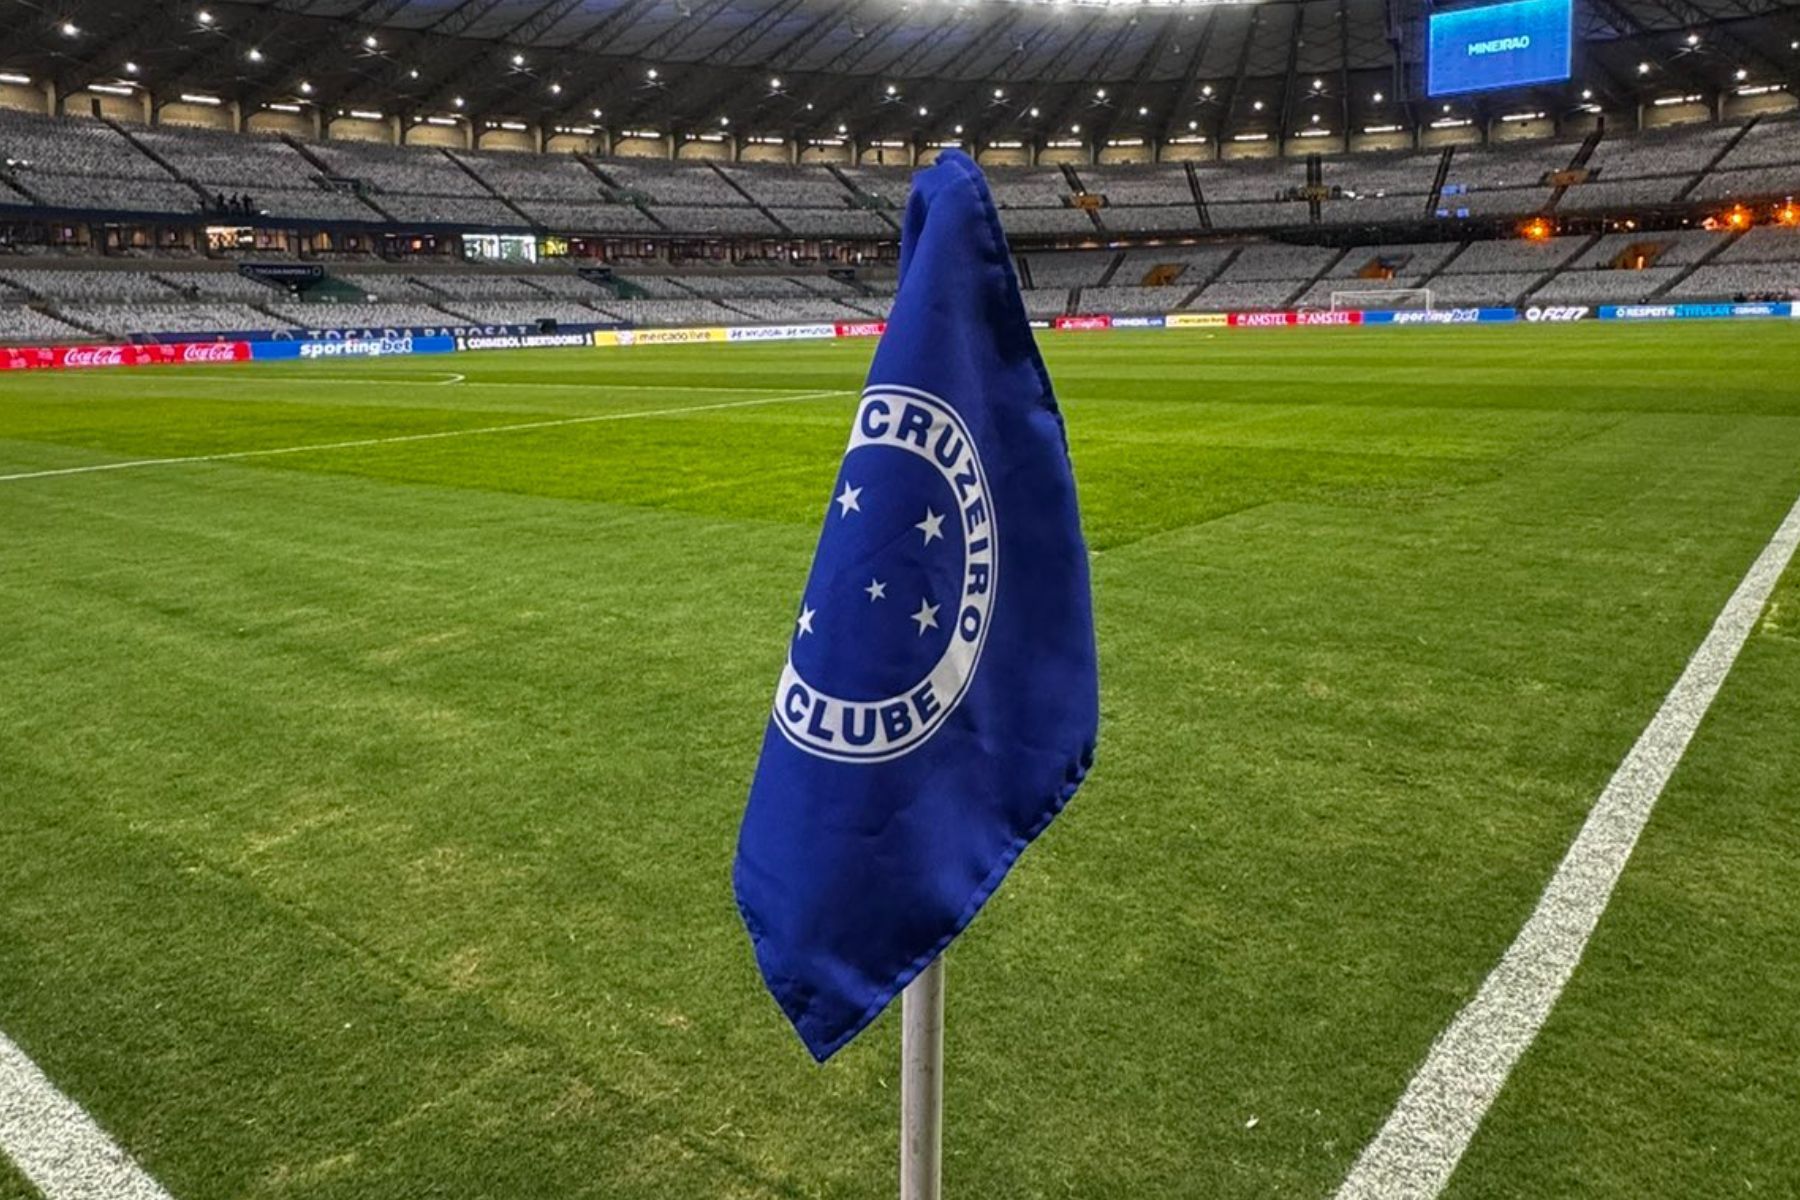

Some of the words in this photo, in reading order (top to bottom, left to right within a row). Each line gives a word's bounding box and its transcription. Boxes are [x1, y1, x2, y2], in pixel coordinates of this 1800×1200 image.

[1246, 313, 1288, 325] AMSTEL
[1306, 311, 1350, 324] AMSTEL
[1393, 309, 1480, 323] sportingbet
[639, 333, 688, 341] mercado
[300, 337, 413, 358] sportingbet
[860, 400, 991, 643] CRUZEIRO
[784, 680, 942, 746] CLUBE
